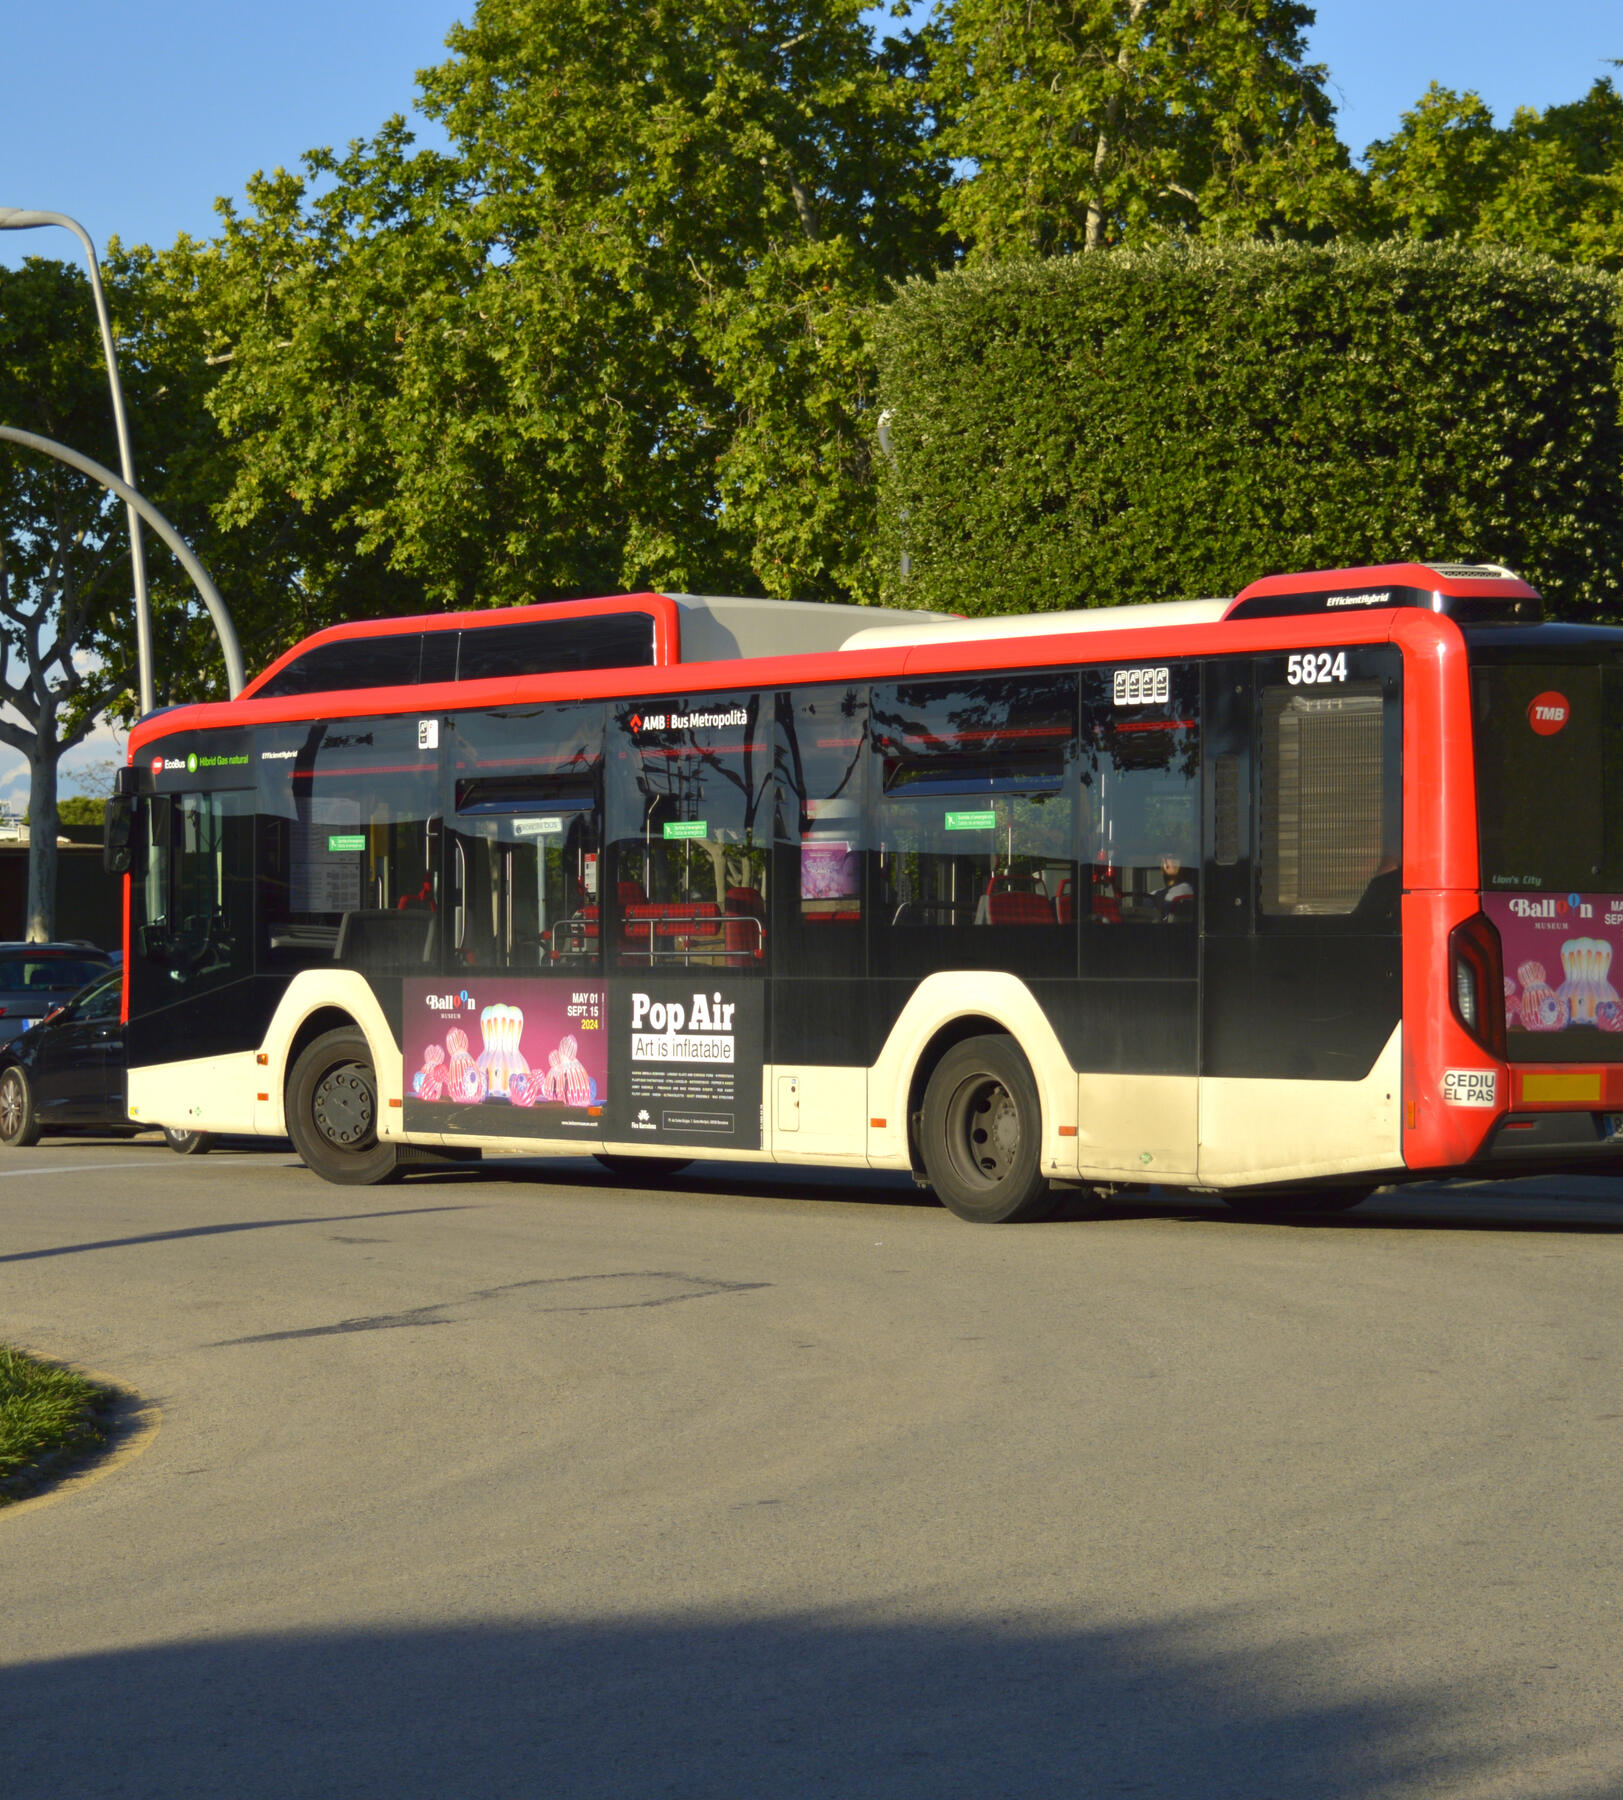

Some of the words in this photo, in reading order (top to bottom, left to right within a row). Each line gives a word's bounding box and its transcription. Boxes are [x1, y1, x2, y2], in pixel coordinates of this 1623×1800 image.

[1326, 592, 1389, 606] EfficientHybrid
[1287, 652, 1347, 685] 5824
[643, 715, 666, 730] AMB
[670, 714, 689, 729] Bus
[690, 709, 748, 729] Metropolità
[1535, 706, 1565, 721] TMB
[164, 758, 186, 769] EcoBus
[217, 755, 229, 766] Gas
[1492, 875, 1519, 884] Lion's
[1522, 875, 1542, 887] City
[1509, 893, 1593, 918] Balloon
[1535, 922, 1569, 930] MUSEUM
[426, 990, 476, 1010] Balloon
[572, 993, 588, 1004] MAY
[589, 993, 598, 1004] 01
[567, 1005, 588, 1017] SEPT.
[590, 1005, 599, 1017] 15
[632, 993, 685, 1035] Pop
[688, 992, 735, 1031] Air
[581, 1018, 599, 1030] 2024
[636, 1038, 654, 1056] Art
[657, 1038, 668, 1057] is
[672, 1038, 731, 1059] inflatable
[1444, 1073, 1495, 1088] CEDIU
[1443, 1088, 1462, 1101] EL
[1467, 1089, 1494, 1101] PAS
